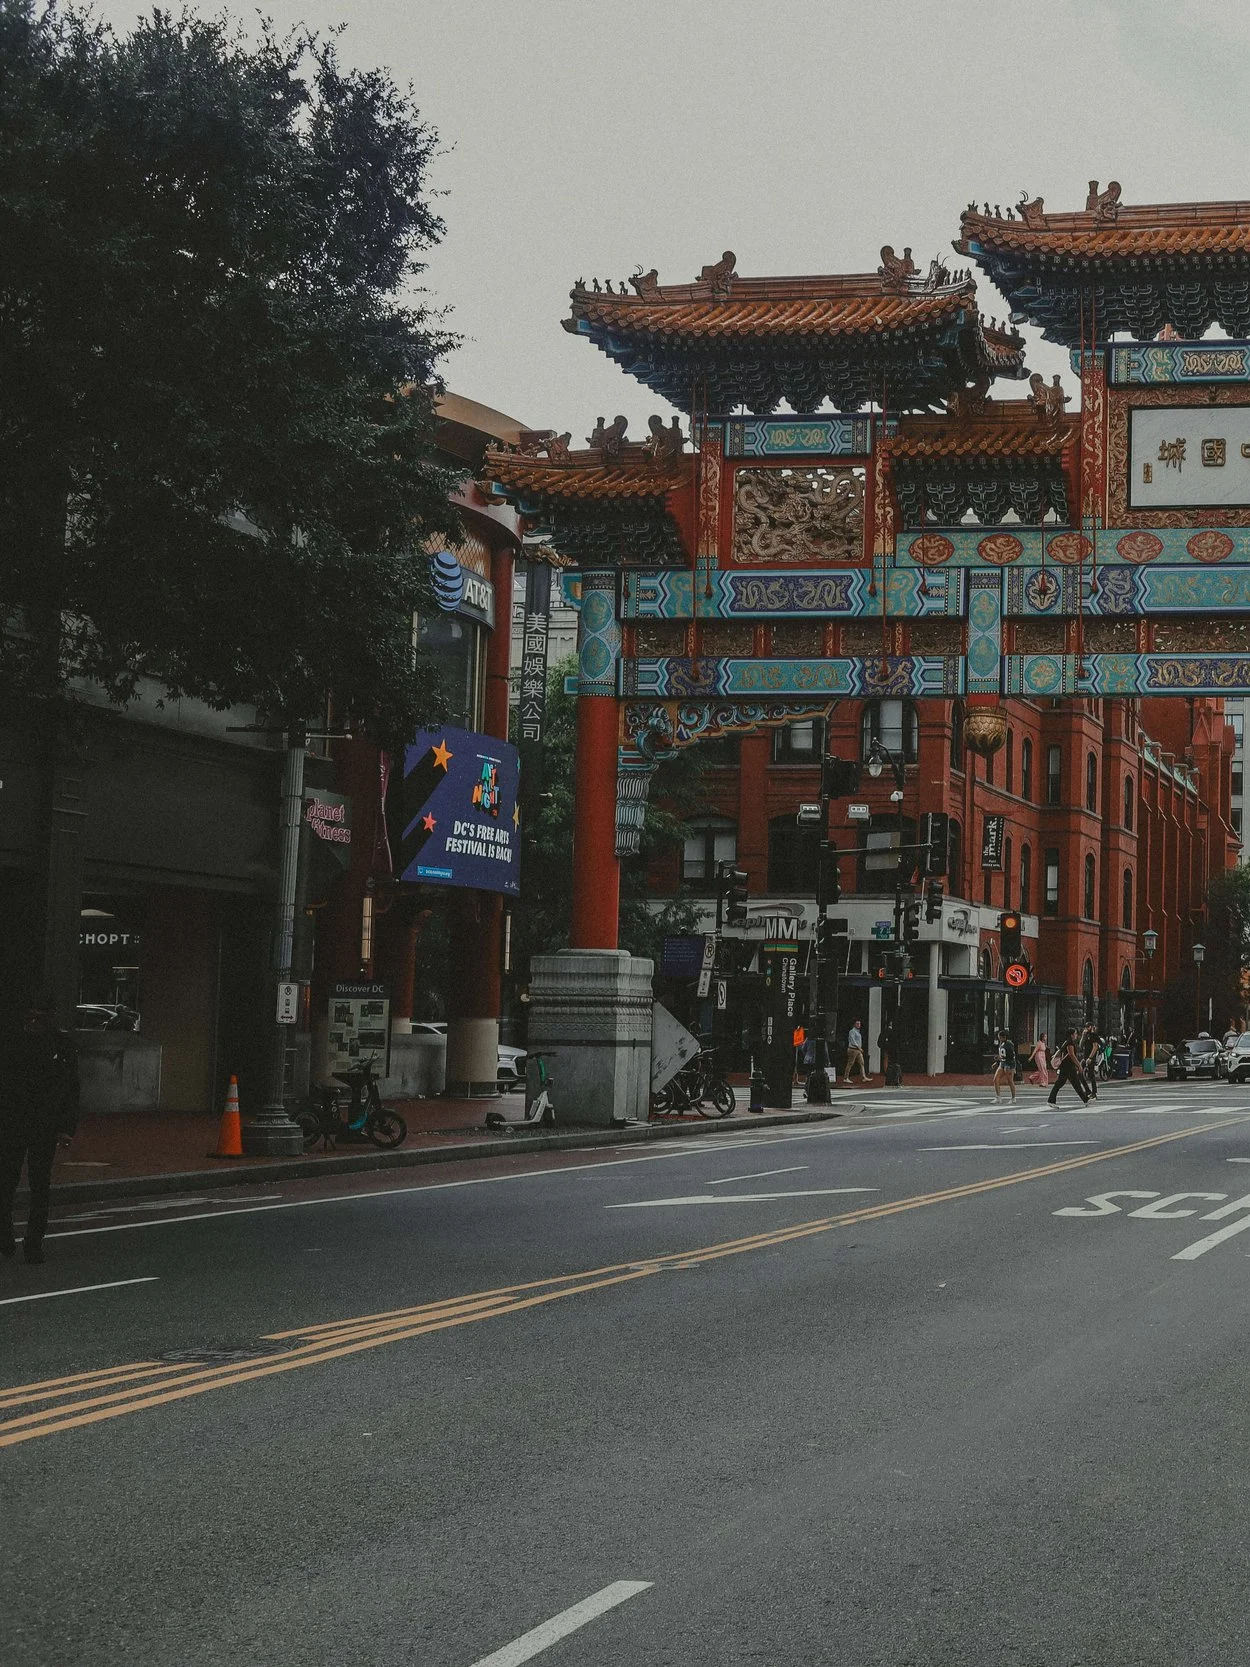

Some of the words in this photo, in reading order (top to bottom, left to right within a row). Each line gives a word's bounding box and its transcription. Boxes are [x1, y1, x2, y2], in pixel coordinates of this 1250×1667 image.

[464, 577, 493, 612] AT&T
[521, 611, 548, 742] 美國娛樂公司
[303, 797, 345, 823] planet
[453, 820, 475, 838] DC'S
[476, 824, 494, 843] FREE
[494, 828, 510, 845] ARTS
[445, 837, 487, 857] FESTIVAL
[487, 843, 495, 859] IS
[781, 957, 789, 993] Chinatown
[787, 957, 798, 990] Gallery
[335, 984, 370, 993] Discover
[372, 984, 384, 993] DC
[787, 992, 796, 1017] Place
